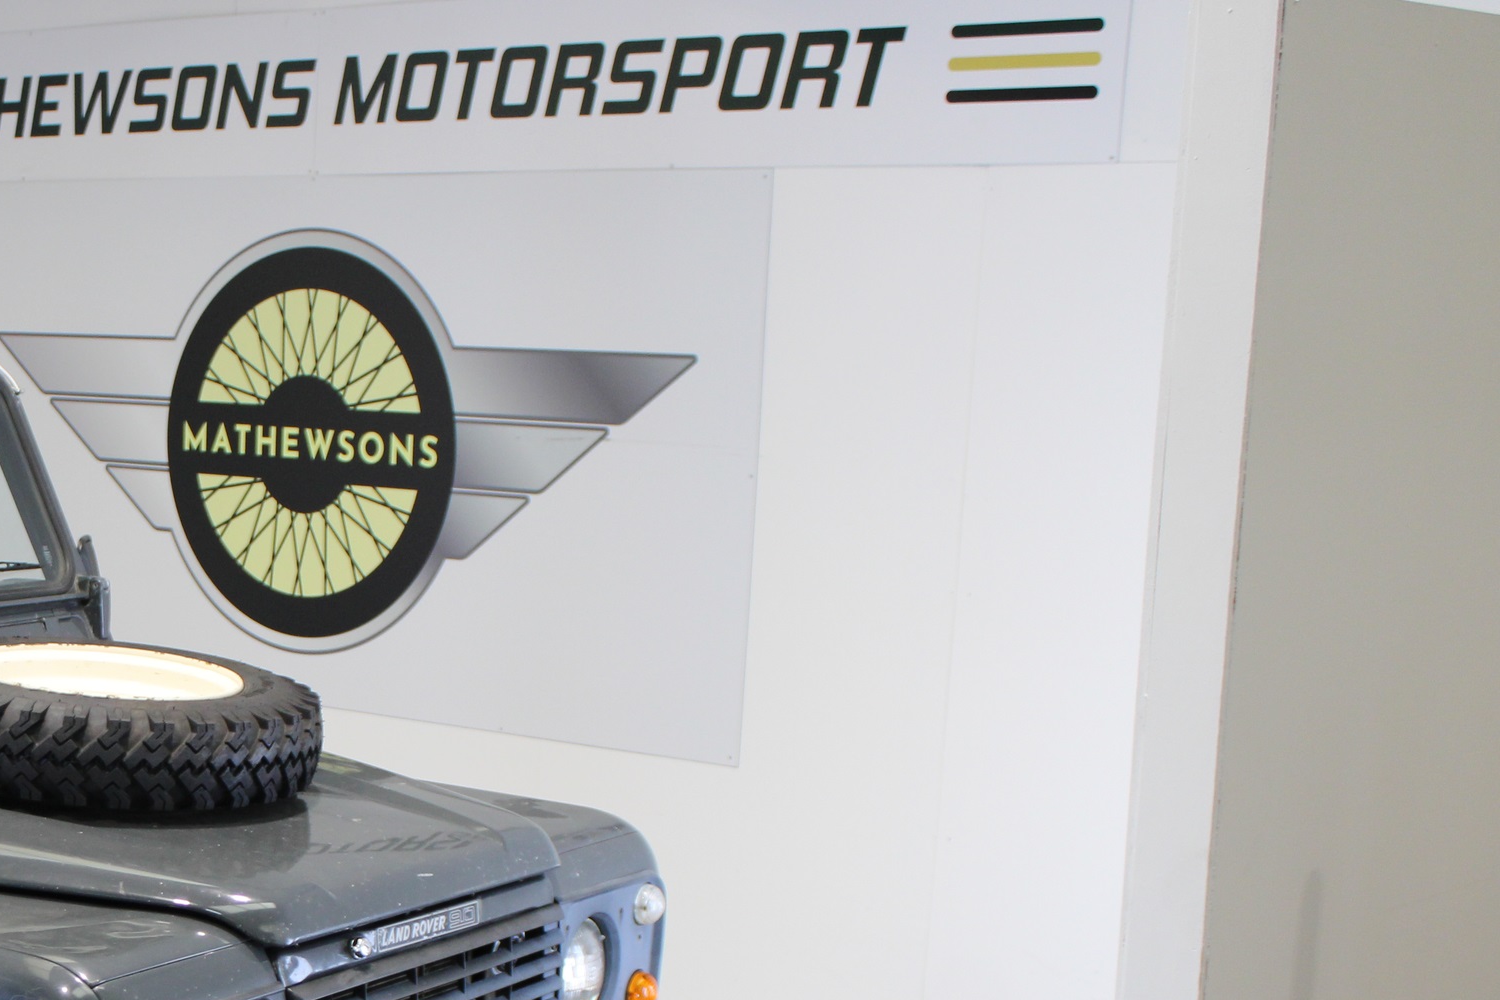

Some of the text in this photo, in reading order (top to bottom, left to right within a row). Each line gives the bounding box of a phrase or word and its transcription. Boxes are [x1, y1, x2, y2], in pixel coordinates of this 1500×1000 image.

[333, 26, 909, 126] MOTORSPORT
[182, 419, 439, 469] MATHEWSONS
[382, 905, 476, 947] LAND ROVER 90
